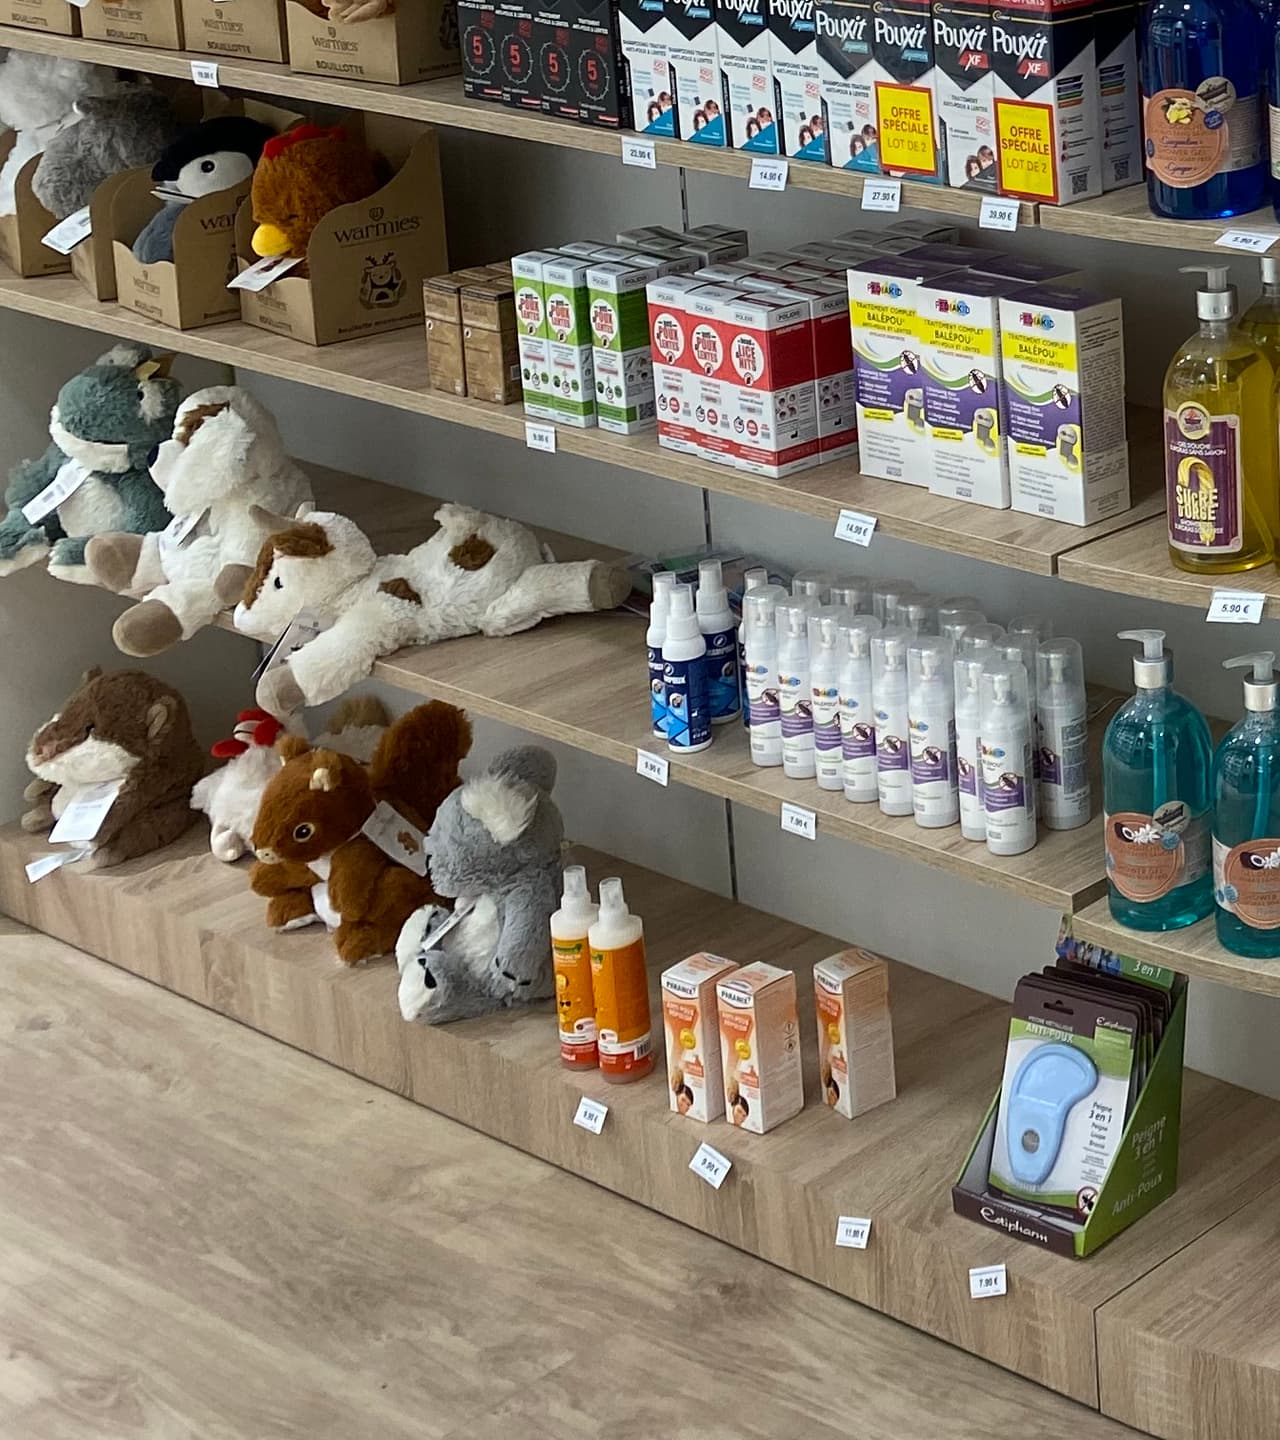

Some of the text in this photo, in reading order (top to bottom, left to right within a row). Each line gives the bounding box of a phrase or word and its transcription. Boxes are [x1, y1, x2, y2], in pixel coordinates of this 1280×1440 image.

[816, 10, 867, 46] Pouxit
[874, 17, 927, 56] Pouxit
[933, 18, 987, 57] Pouxit
[992, 25, 1048, 64] Pouxit
[316, 60, 364, 76] BOUILLOTTE
[891, 106, 921, 122] OFFRE
[882, 117, 929, 136] SPÉCIALE
[1010, 125, 1042, 141] OFFRE
[887, 137, 928, 153] LOT DE 2
[1001, 136, 1050, 157] SPÉCIALE
[1006, 158, 1048, 174] LOT DE 2
[334, 215, 421, 244] warmies
[867, 311, 904, 326] BALÉPOU
[934, 329, 971, 344] BALÉPOU
[1018, 343, 1055, 359] BALÉPOU
[1176, 486, 1219, 509] SUCRE
[1133, 960, 1141, 972] 3
